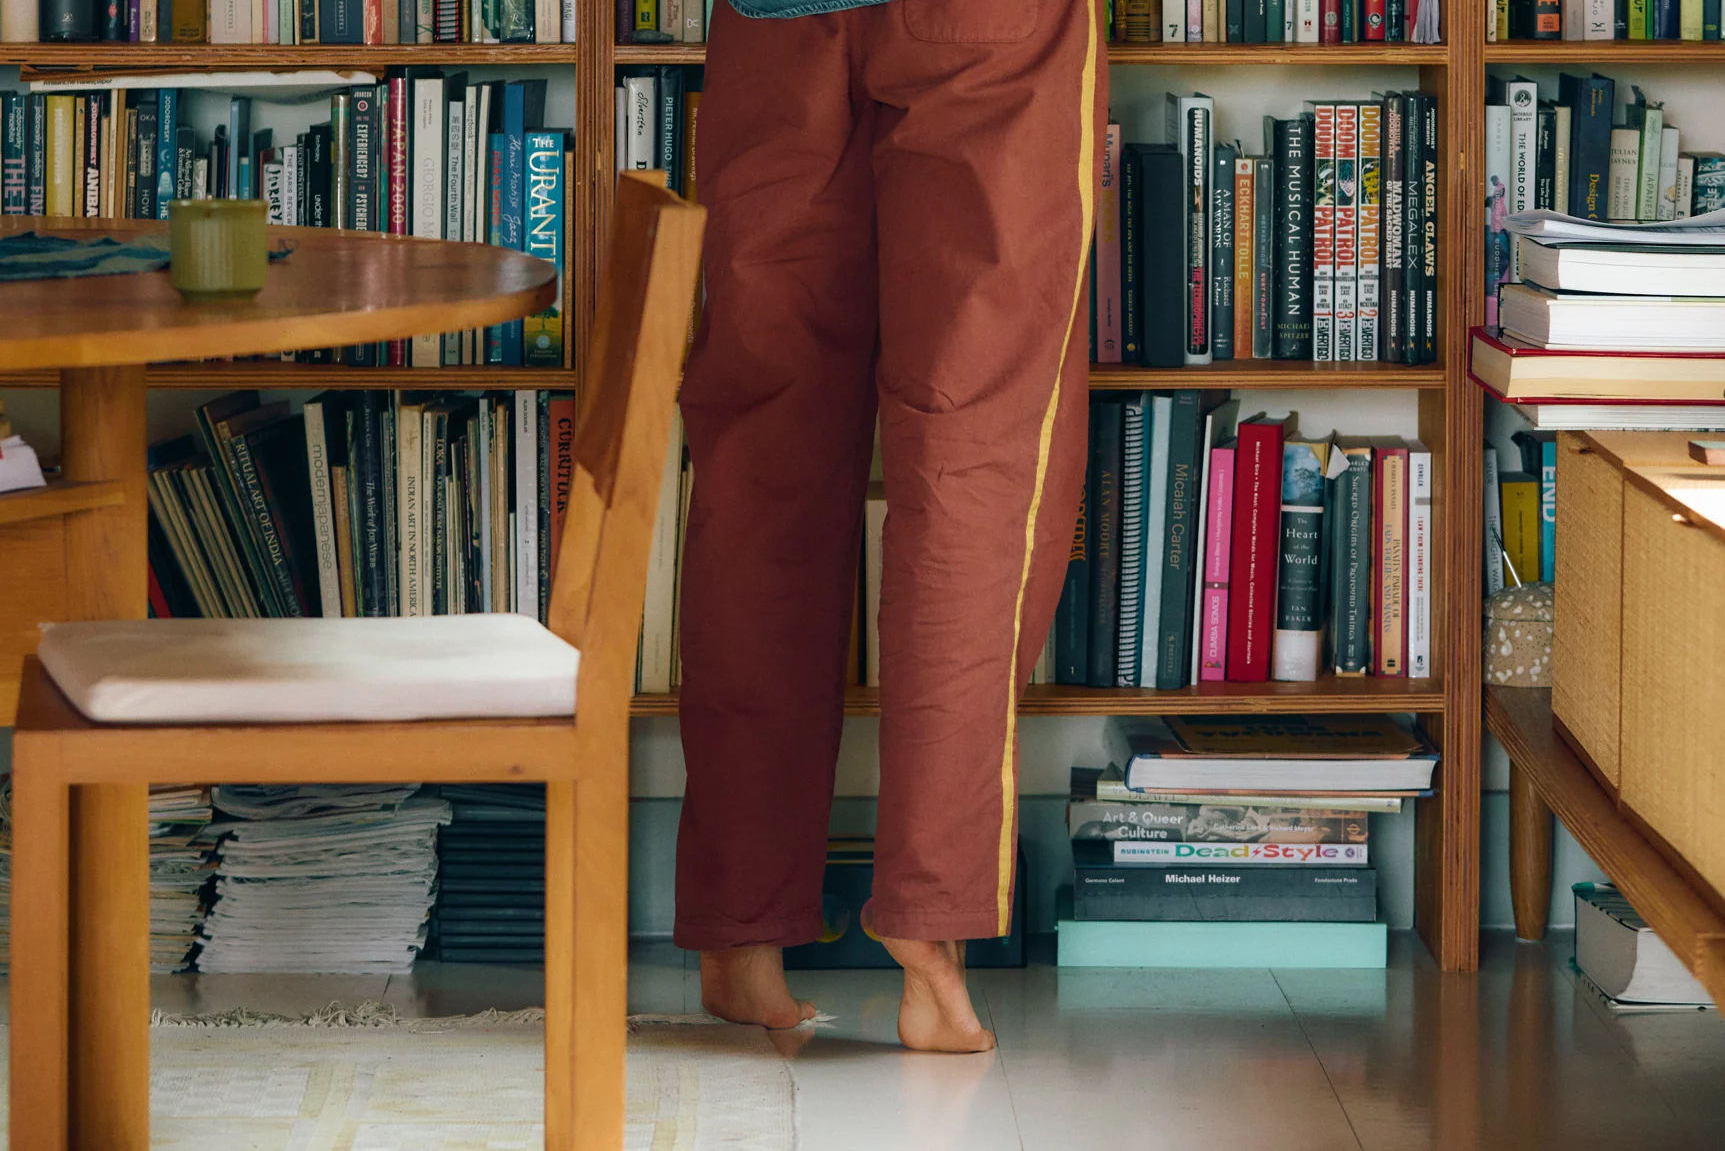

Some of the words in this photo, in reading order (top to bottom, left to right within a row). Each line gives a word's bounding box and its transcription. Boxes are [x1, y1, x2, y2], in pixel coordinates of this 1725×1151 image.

[356, 124, 369, 178] EXPERIENCED?
[393, 118, 405, 177] JAPAN
[1289, 127, 1301, 158] THE
[1316, 108, 1333, 158] DOOM
[1337, 109, 1355, 157] DOOM
[1361, 107, 1379, 157] DOOM
[1518, 133, 1526, 149] THE
[450, 156, 459, 172] The
[1518, 152, 1526, 183] WORLD
[393, 183, 404, 223] 2000
[450, 174, 459, 203] Fourth
[1239, 179, 1249, 236] ECKHART
[1289, 166, 1299, 243] MUSICAL
[1425, 161, 1434, 216] ANGEL
[1518, 186, 1525, 197] OF
[450, 205, 458, 222] Wall
[1409, 181, 1417, 269] MEGALEX
[1239, 240, 1249, 279] TOLLE
[1314, 207, 1332, 270] PATROL
[1336, 207, 1355, 270] PATROL
[1360, 205, 1379, 269] PATROL
[1425, 221, 1434, 276] CLAWS
[1288, 251, 1299, 315] HUMAN
[1173, 464, 1188, 519] Micaiah
[1170, 524, 1185, 569] Carter
[1286, 529, 1318, 539] Heart
[1284, 554, 1318, 565] World
[1102, 812, 1126, 823] Art
[1128, 813, 1139, 824] &
[1143, 813, 1183, 825] Queer
[1117, 826, 1167, 839] Culture
[1175, 845, 1249, 858] Dead
[1263, 845, 1338, 860] Style
[1165, 874, 1205, 884] Michael
[1208, 874, 1240, 884] Heizer
